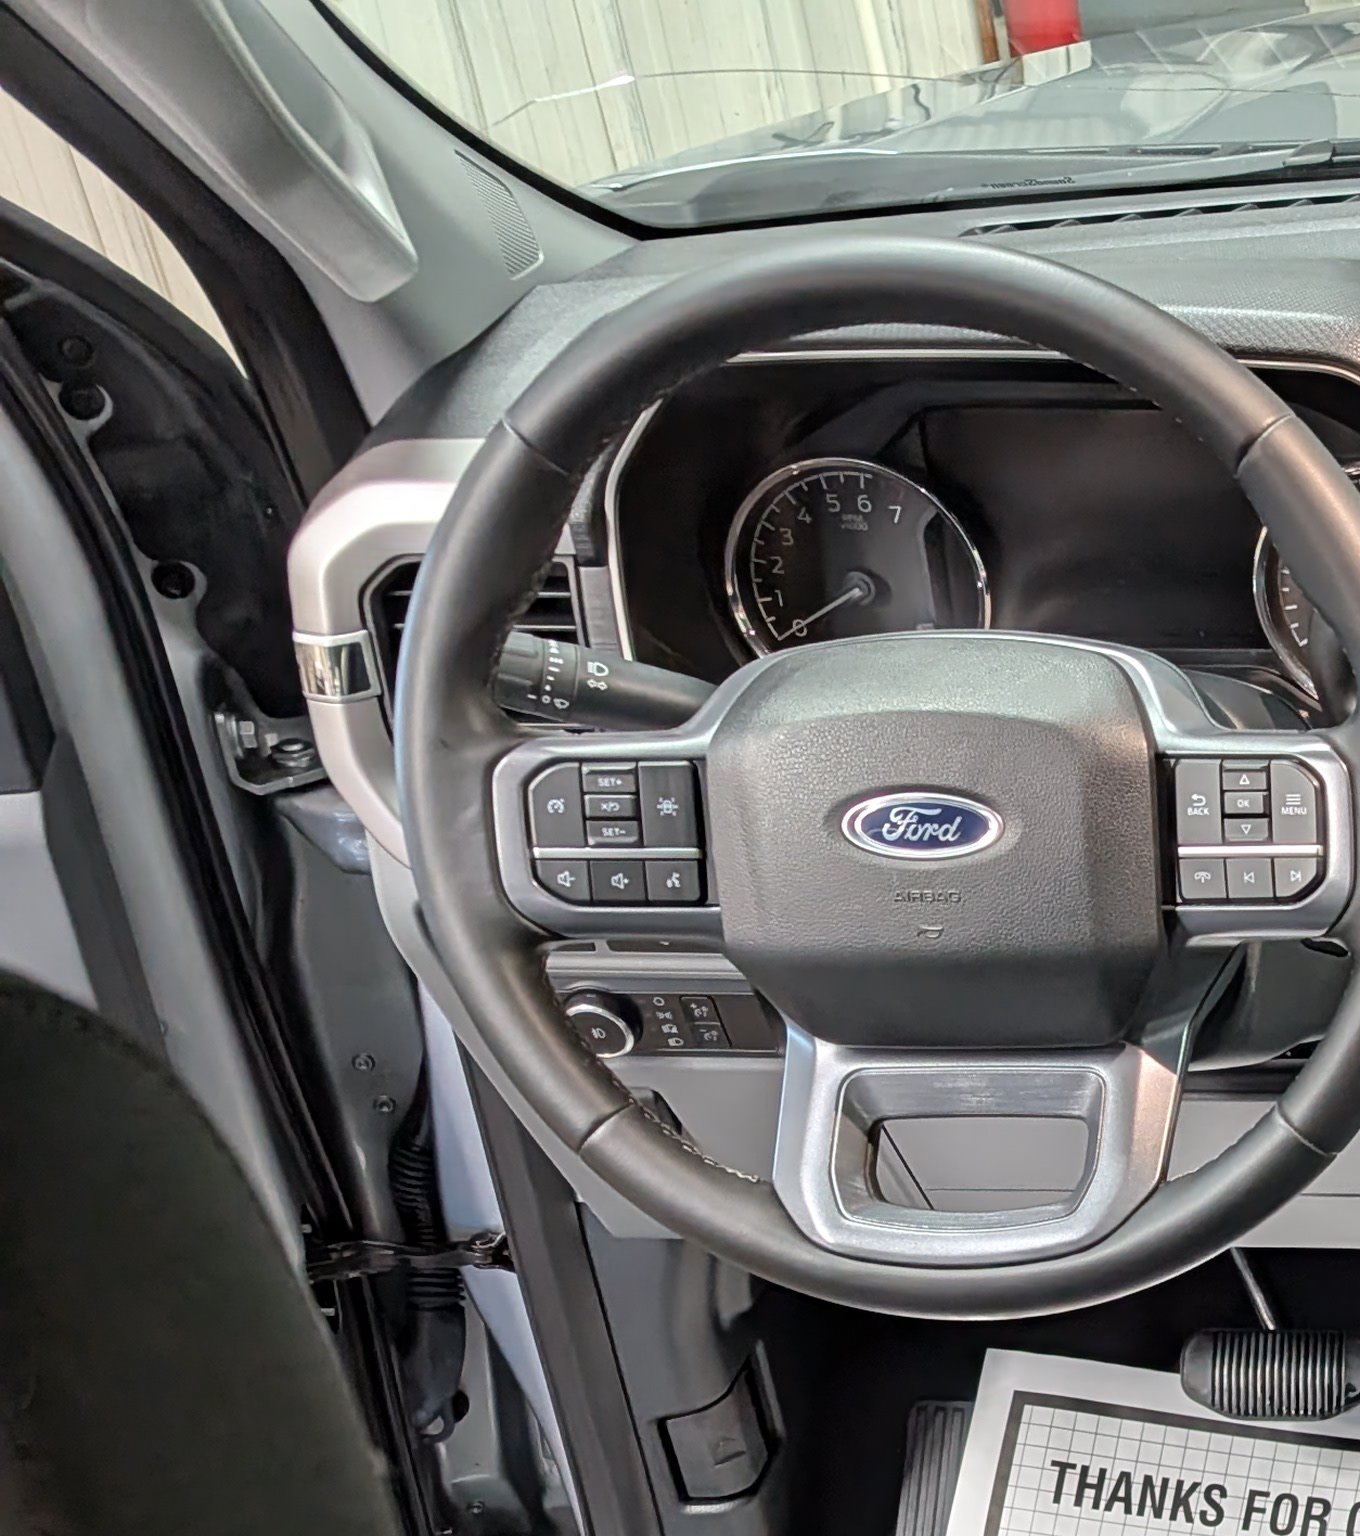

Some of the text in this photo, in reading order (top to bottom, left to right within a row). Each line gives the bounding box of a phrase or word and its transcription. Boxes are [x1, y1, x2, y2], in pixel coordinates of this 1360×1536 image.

[826, 494, 840, 512] 5
[857, 494, 872, 512] 6
[797, 507, 812, 524] 4
[888, 506, 902, 524] 7
[779, 528, 794, 545] 3
[769, 556, 784, 574] 2
[774, 590, 783, 607] 1
[792, 619, 807, 637] 0
[1187, 807, 1210, 816] BACK
[1237, 799, 1250, 808] OK
[1281, 807, 1307, 816] MENU
[881, 806, 963, 842] Ford
[893, 889, 962, 904] AIRBAG
[1050, 1459, 1228, 1527] THANKS
